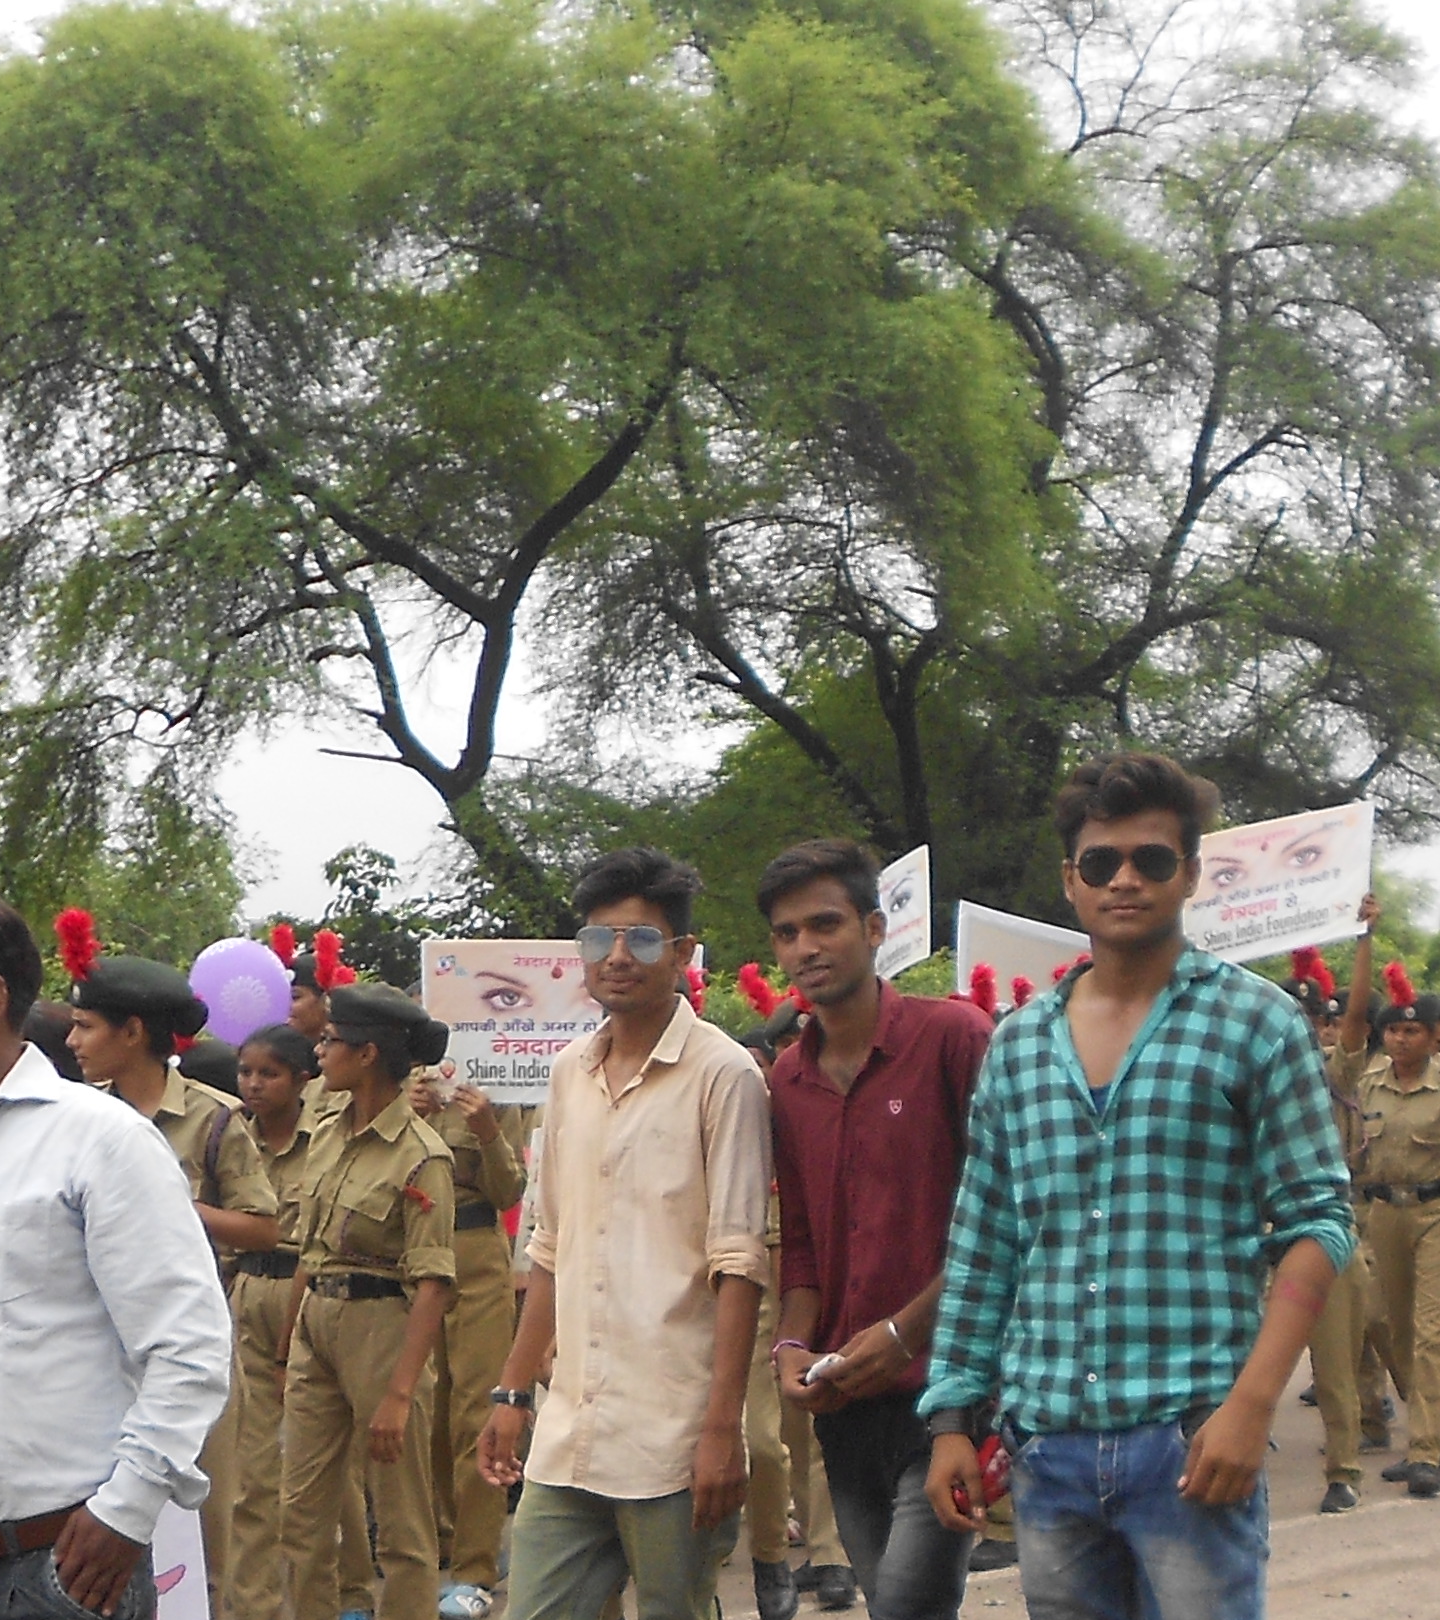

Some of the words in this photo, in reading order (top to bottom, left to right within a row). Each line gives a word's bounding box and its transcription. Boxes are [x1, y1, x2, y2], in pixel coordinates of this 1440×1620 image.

[1204, 928, 1232, 946] Shine
[1236, 920, 1263, 940] India
[1266, 905, 1329, 931] Foundation
[452, 1018, 497, 1032] आपकी
[541, 1021, 576, 1032] अमर
[583, 1019, 597, 1032] हो
[466, 1057, 506, 1079] Shine
[512, 1057, 550, 1079] India
